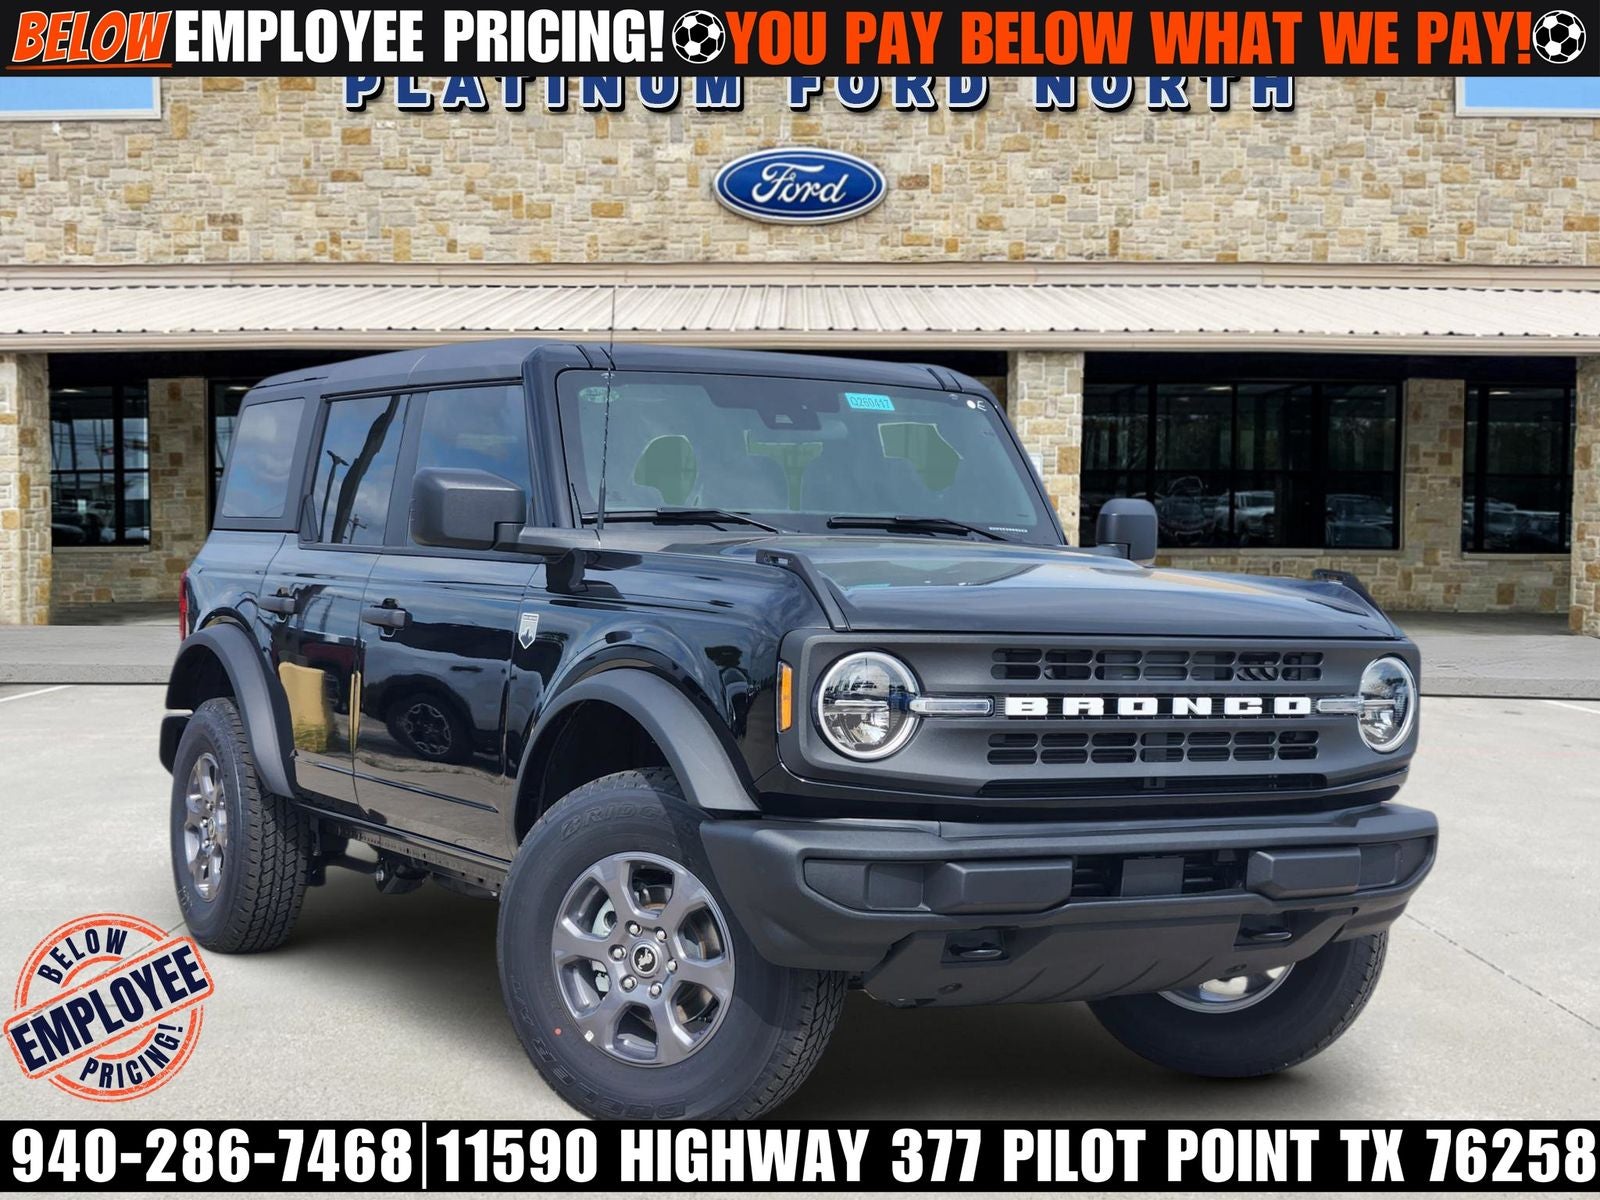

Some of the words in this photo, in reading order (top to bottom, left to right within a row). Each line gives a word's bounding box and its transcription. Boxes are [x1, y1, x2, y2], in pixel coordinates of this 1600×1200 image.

[343, 76, 742, 110] PLATINUM
[786, 76, 987, 110] FORD
[1034, 76, 1296, 110] NORTH
[752, 162, 849, 203] Ford
[1005, 696, 1312, 717] BRONCO
